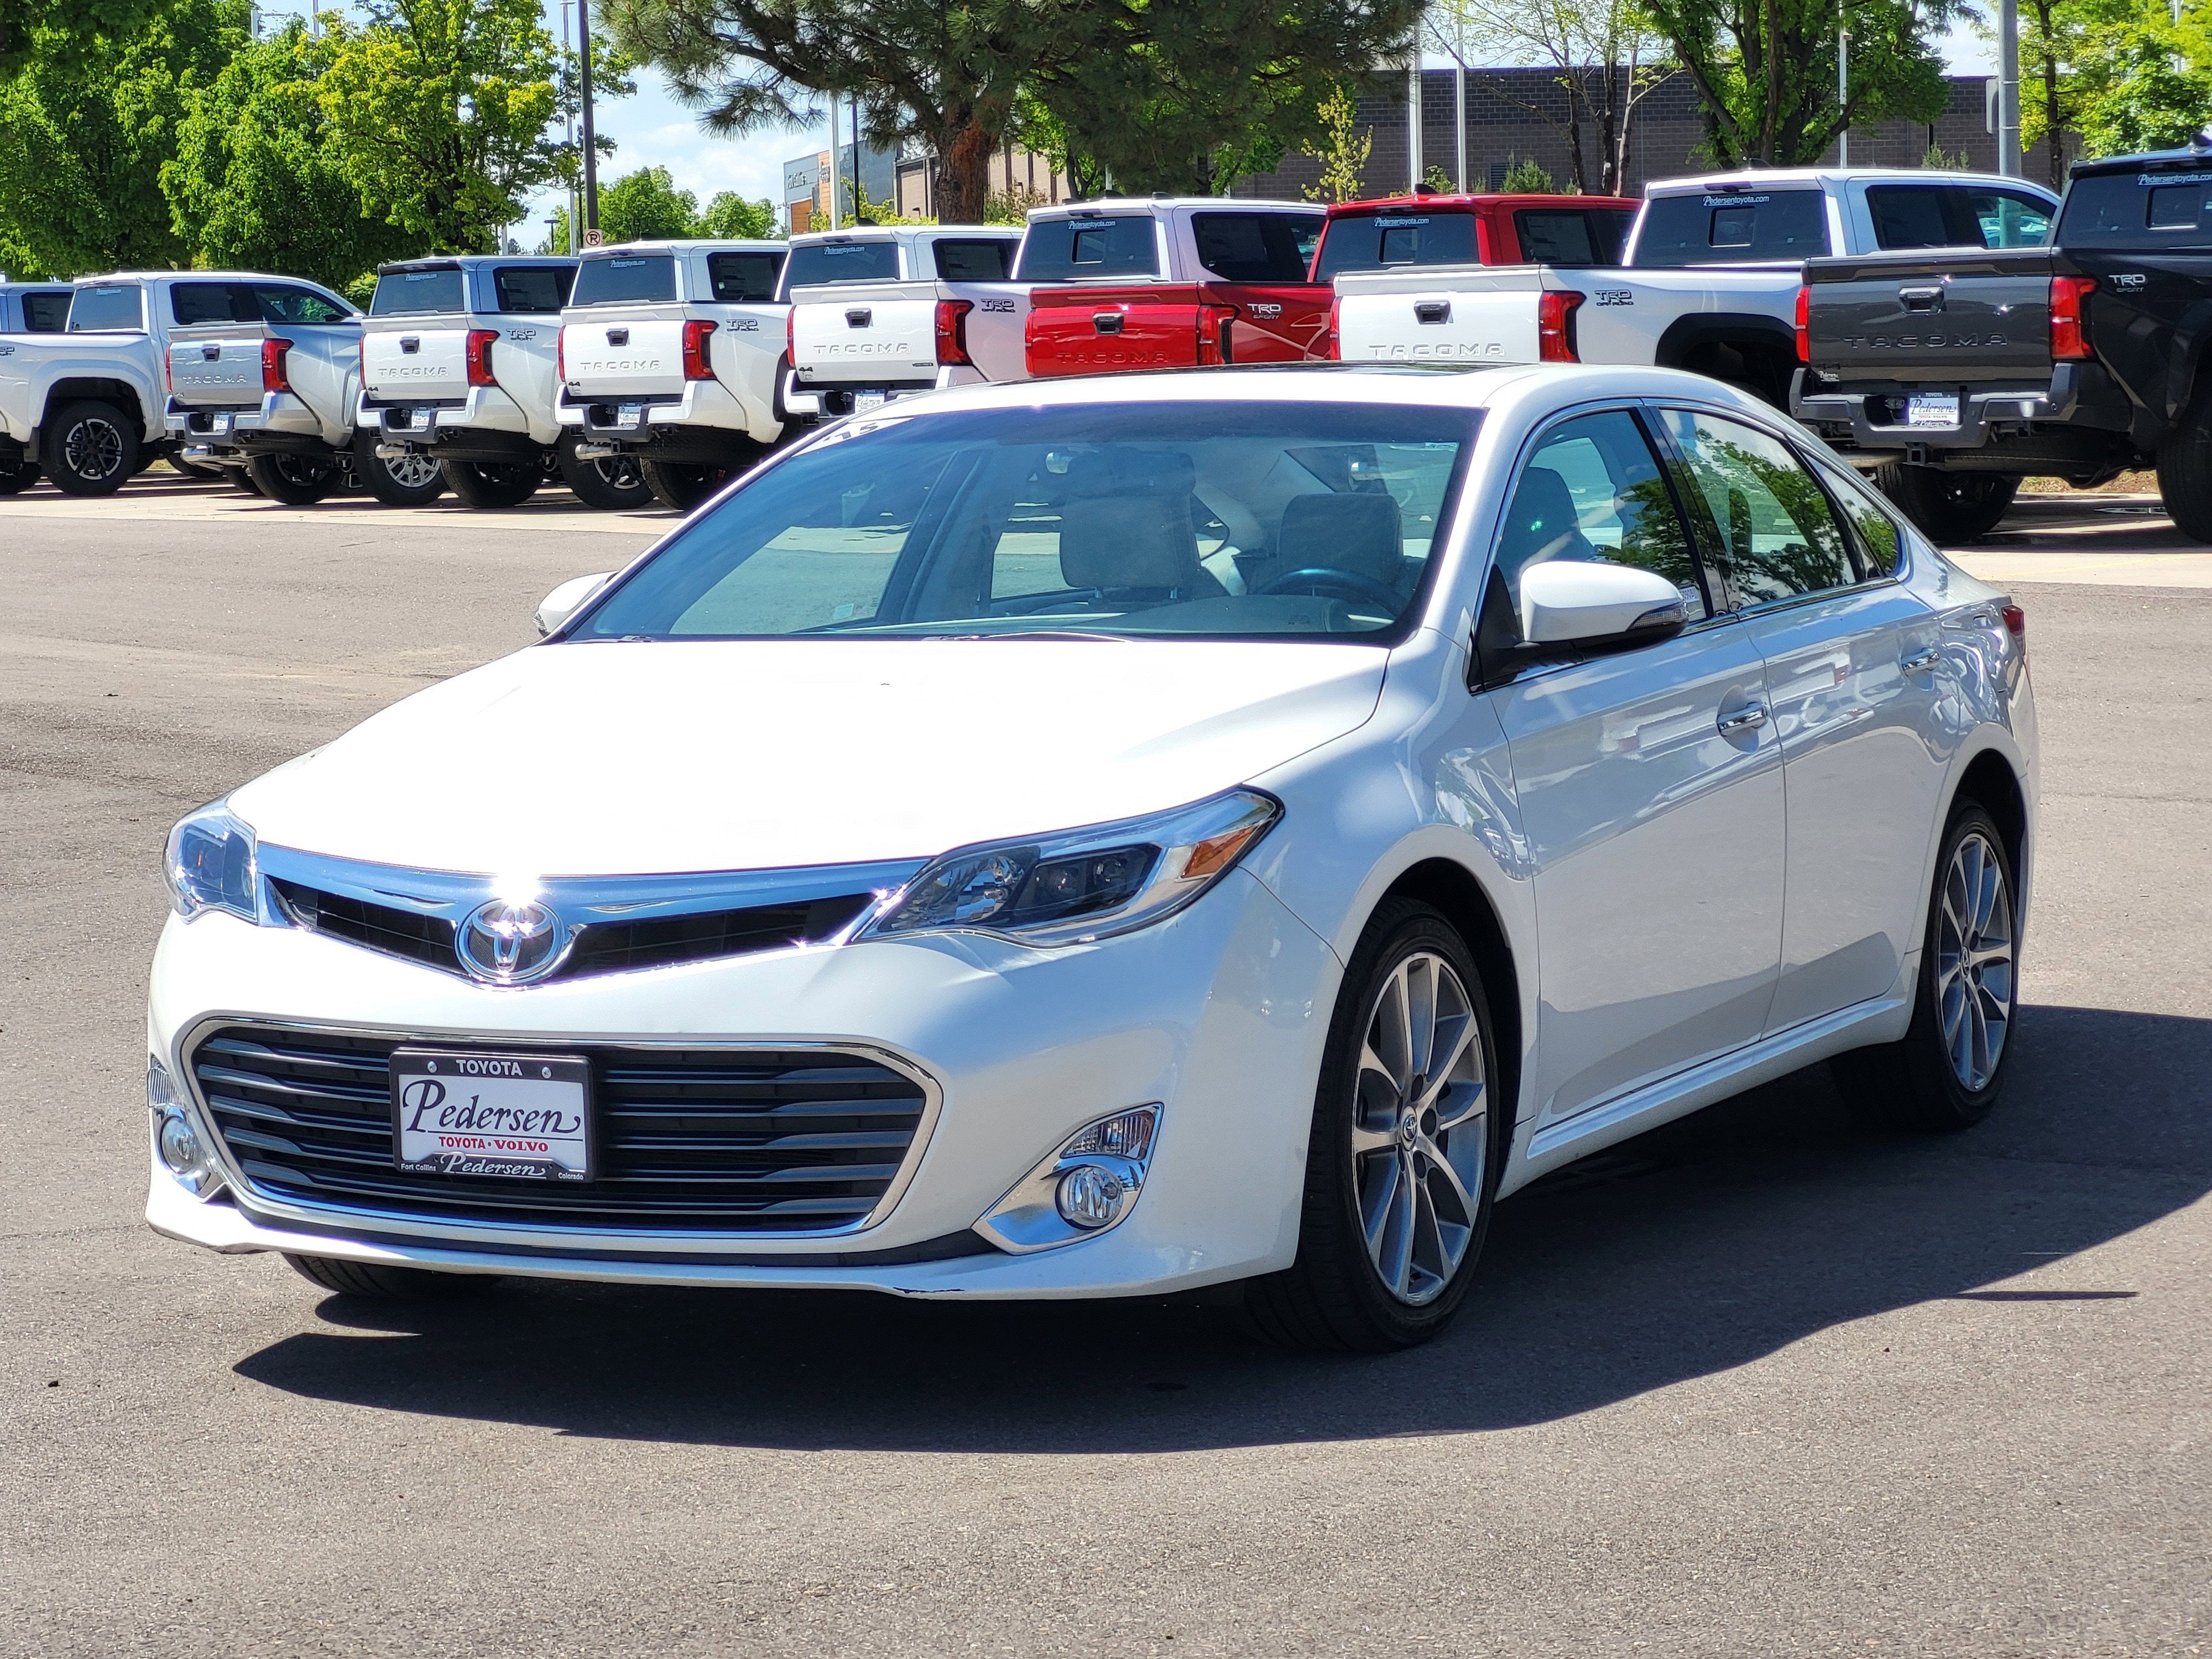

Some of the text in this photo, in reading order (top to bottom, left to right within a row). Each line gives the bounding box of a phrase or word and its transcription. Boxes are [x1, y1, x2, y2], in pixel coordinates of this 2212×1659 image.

[1703, 195, 1770, 206] Pedersentoyota.com
[1374, 217, 1429, 227] Pedersentoyota.com
[2108, 274, 2146, 286] TRD
[1594, 289, 1632, 301] TRD
[980, 299, 1014, 309] TRD
[1247, 304, 1282, 314] TRD
[726, 319, 758, 328] TRD
[506, 328, 536, 337] TRD
[1843, 333, 2007, 348] TACOMA
[813, 342, 911, 356] TACOMA
[1368, 343, 1505, 359] TACOMA
[1056, 352, 1168, 364] TACOMA
[378, 366, 449, 378] TACOMA
[580, 360, 663, 372] TACOMA
[182, 375, 247, 384] TACOMA
[1910, 399, 1957, 414] Pedersen
[455, 1060, 523, 1076] TOYOTA
[402, 1079, 582, 1134] Pedersen
[439, 1136, 549, 1152] TOYOTA VOLVO
[440, 1151, 546, 1176] Pedersen
[557, 1172, 585, 1181] Colorado
